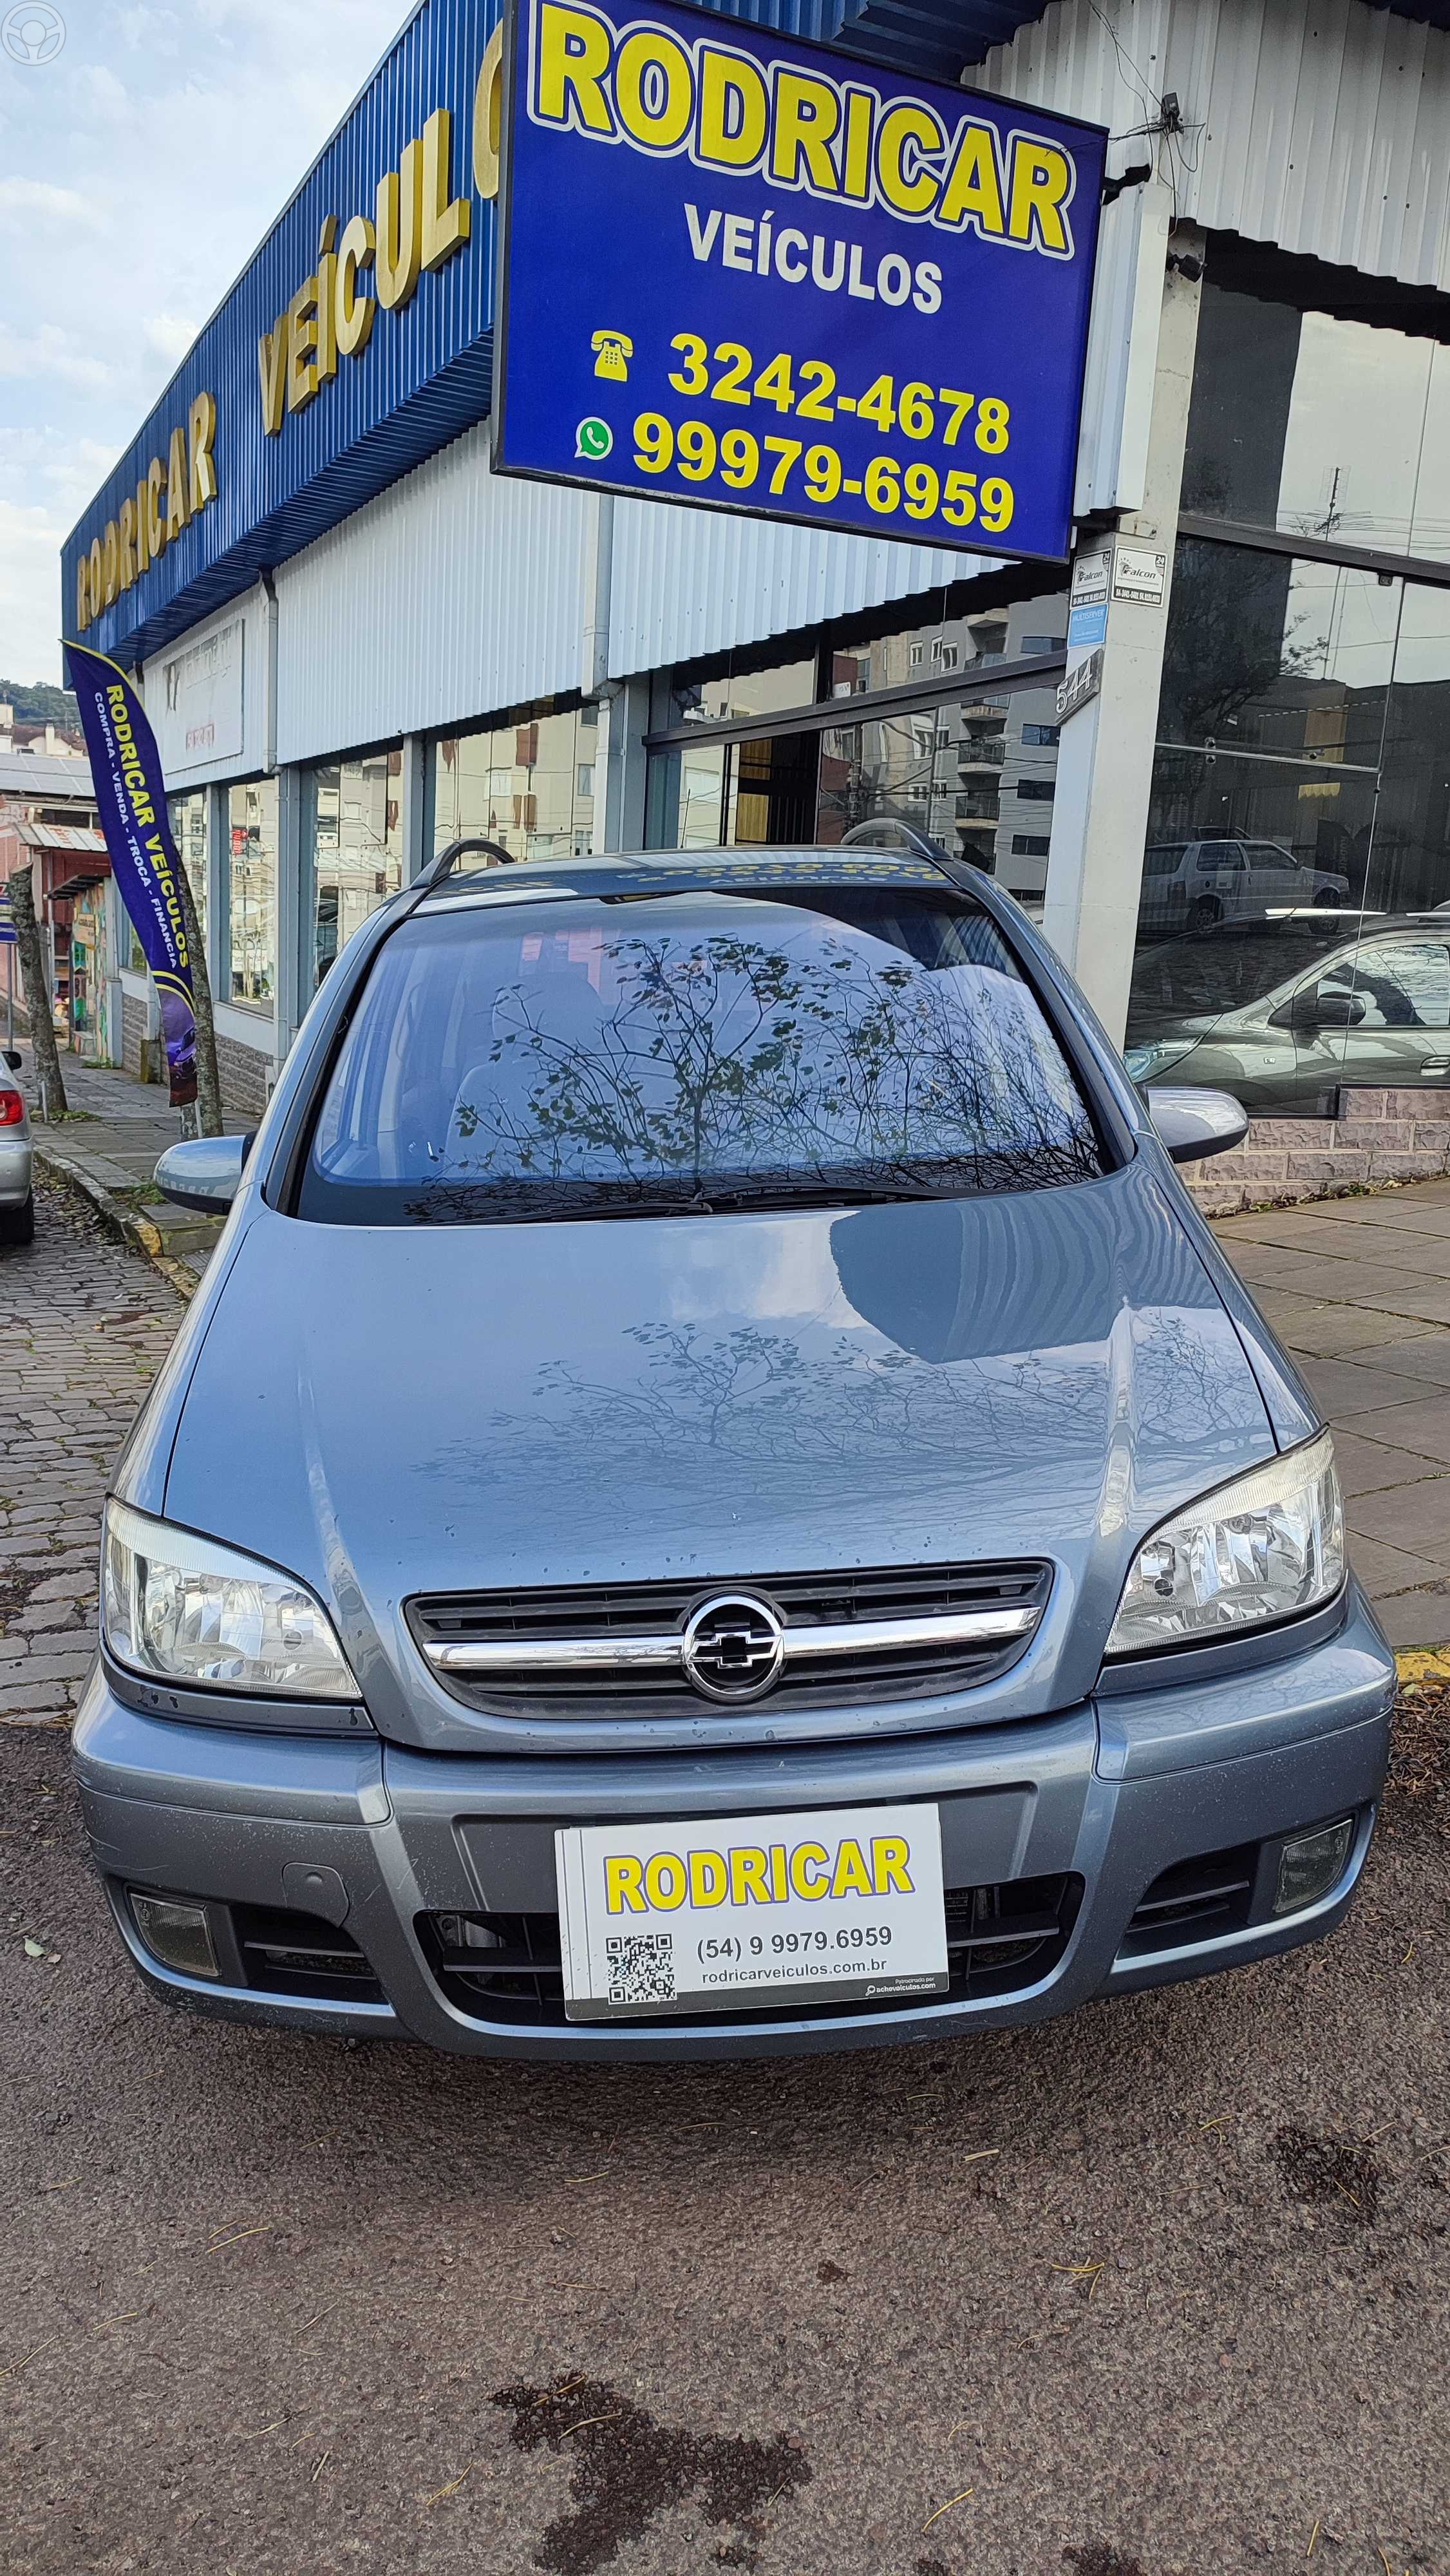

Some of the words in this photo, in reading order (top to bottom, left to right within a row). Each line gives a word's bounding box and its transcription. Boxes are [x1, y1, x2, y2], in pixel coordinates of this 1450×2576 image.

[533, 2, 1074, 258] RODRICAR
[684, 203, 943, 314] VEÍCULOS
[668, 333, 1011, 455] 3242-4678
[77, 391, 217, 632] RODRICAR
[632, 412, 1014, 533] 99979-6959
[1078, 571, 1104, 582] Falcon
[1123, 565, 1156, 579] Falcon
[1055, 658, 1093, 714] 544
[95, 692, 116, 759] COMPRA
[112, 771, 129, 825] VENDA
[127, 835, 152, 887] TROCA
[151, 898, 177, 969] FINANCIA
[106, 685, 155, 828] RODRICAR
[144, 833, 189, 968] VEÍCULOS
[603, 1835, 916, 1915] RODRICAR
[697, 1937, 742, 1964] (54)
[749, 1936, 764, 1956] 9
[771, 1926, 892, 1953] 9979.6959
[701, 1958, 888, 1984] rodricarveiculos.com.br
